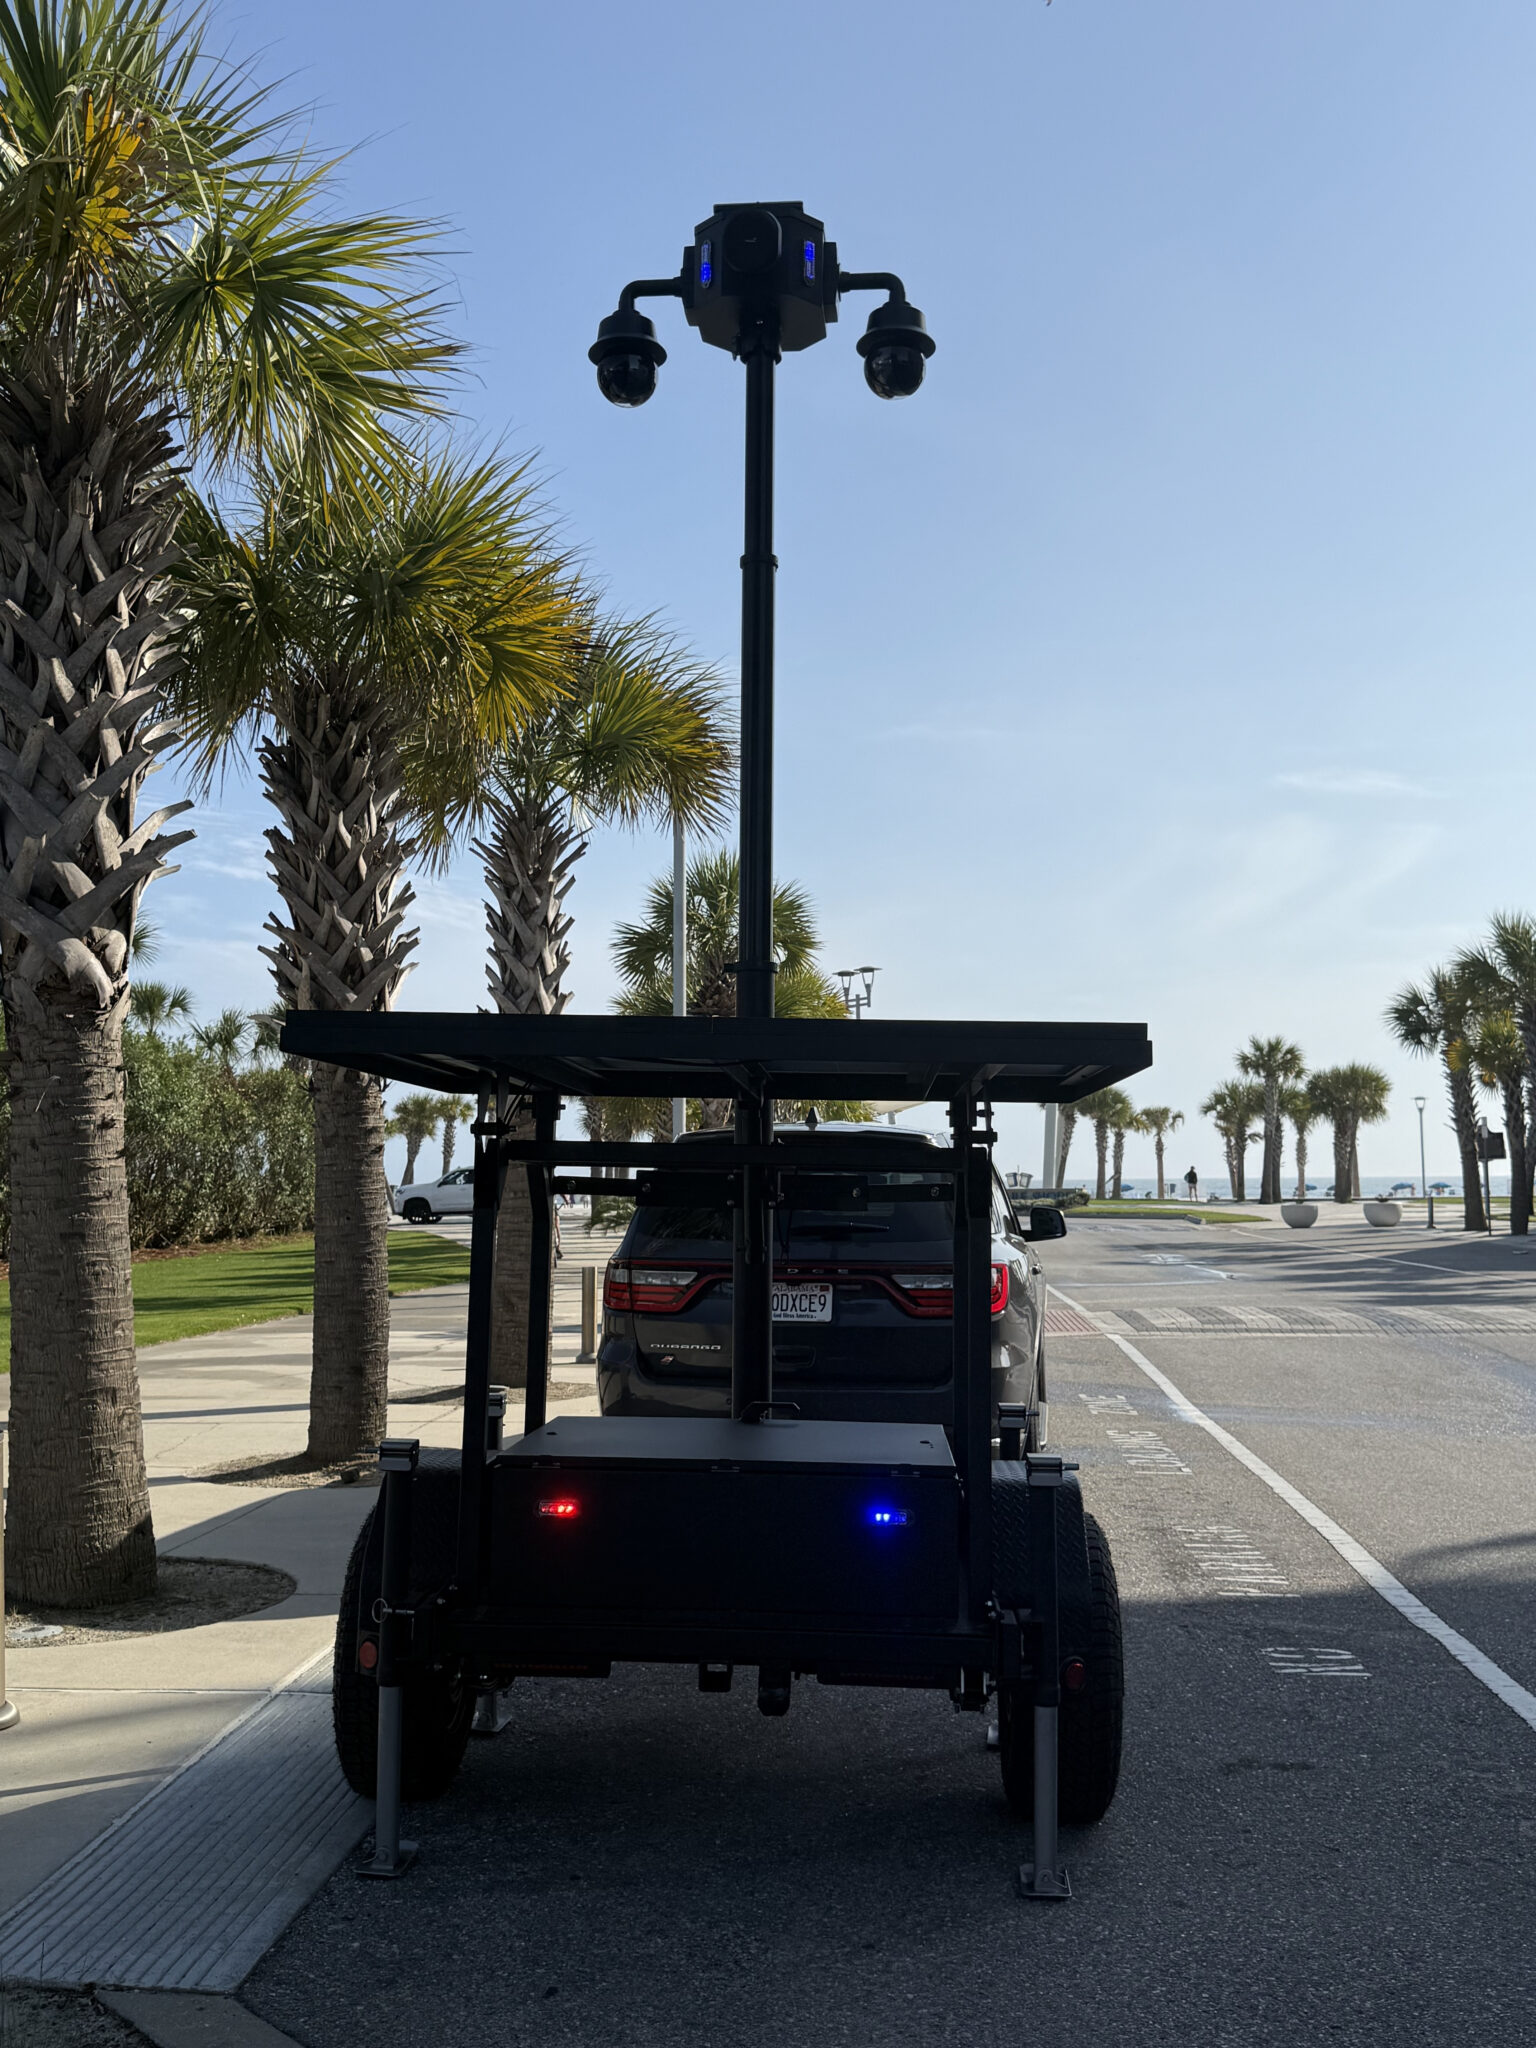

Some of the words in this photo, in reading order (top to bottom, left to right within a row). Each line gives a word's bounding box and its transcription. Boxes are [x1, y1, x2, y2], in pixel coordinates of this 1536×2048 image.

[771, 1293, 827, 1312] 0DXCE9
[1078, 1393, 1139, 1416] ZONE
[1105, 1429, 1193, 1475] LOADING
[1172, 1524, 1301, 1598] PARKING
[1259, 1646, 1374, 1677] NO
